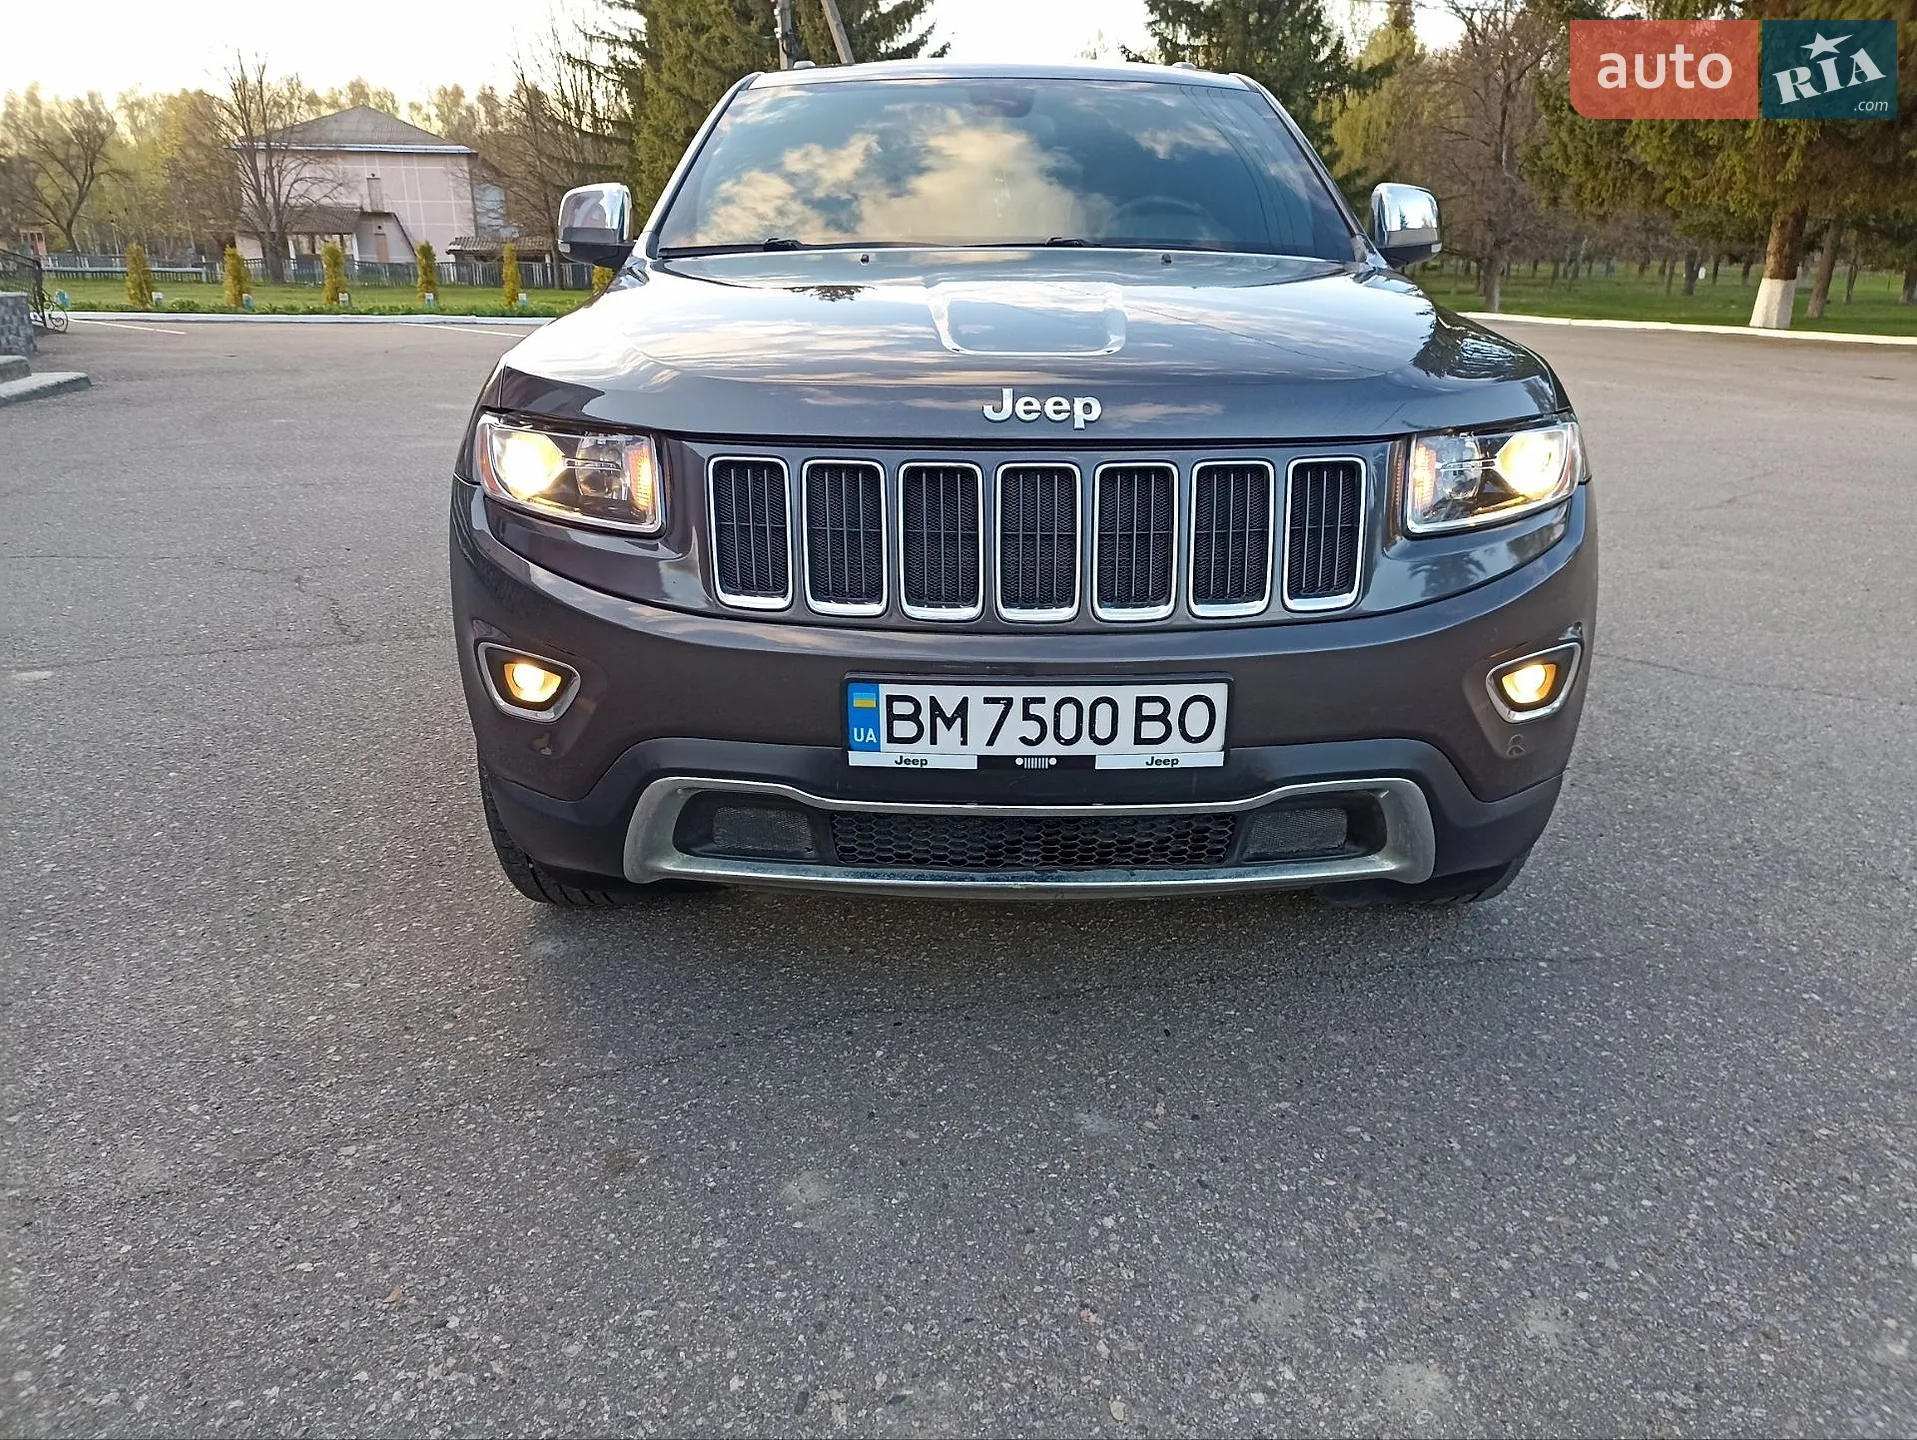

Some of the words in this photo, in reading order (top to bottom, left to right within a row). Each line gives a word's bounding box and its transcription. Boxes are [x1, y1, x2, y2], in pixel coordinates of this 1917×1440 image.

[982, 386, 1102, 430] Jeep
[885, 694, 969, 747] BM
[983, 695, 1119, 747] 7500
[1133, 694, 1217, 746] BO
[853, 728, 877, 744] UA
[894, 755, 928, 768] Jeep
[1145, 755, 1180, 768] Jeep
